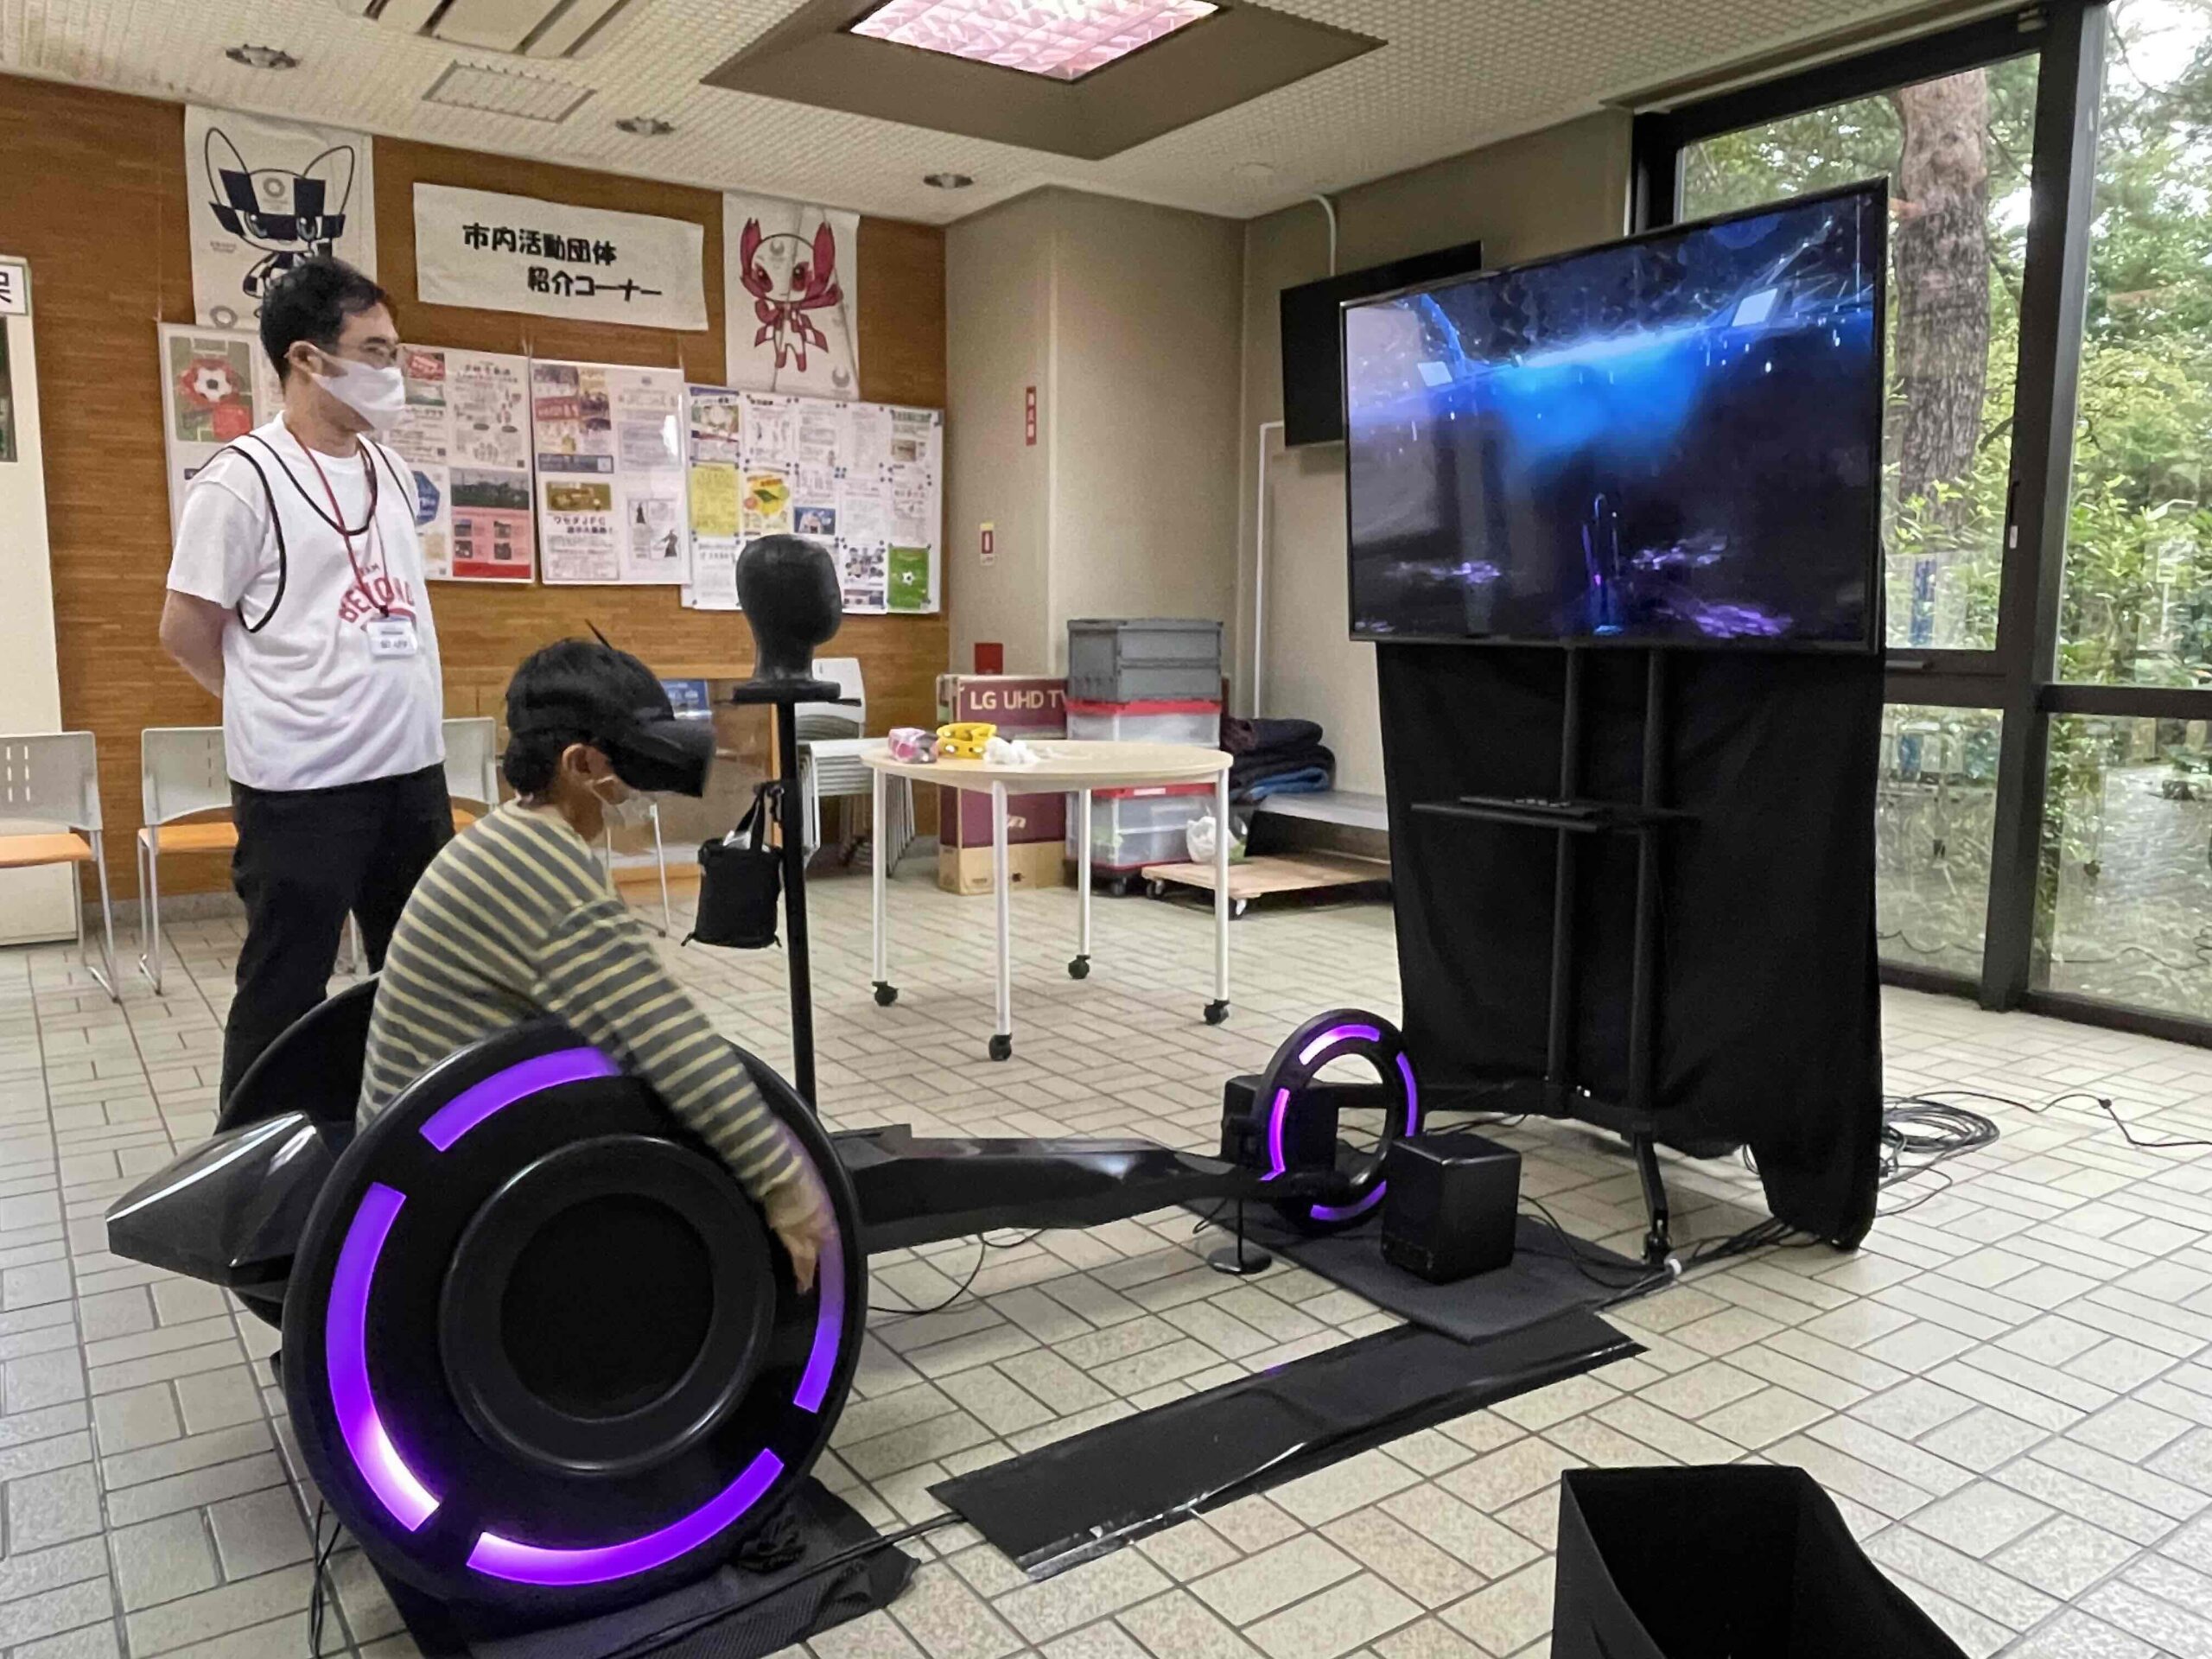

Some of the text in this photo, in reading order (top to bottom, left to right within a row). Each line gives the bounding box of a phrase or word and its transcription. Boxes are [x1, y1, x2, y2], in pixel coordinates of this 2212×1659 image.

[462, 223, 617, 265] 市内活動団体
[528, 266, 662, 302] 紹介コーナー
[970, 690, 996, 710] LG
[1003, 690, 1044, 709] UHD
